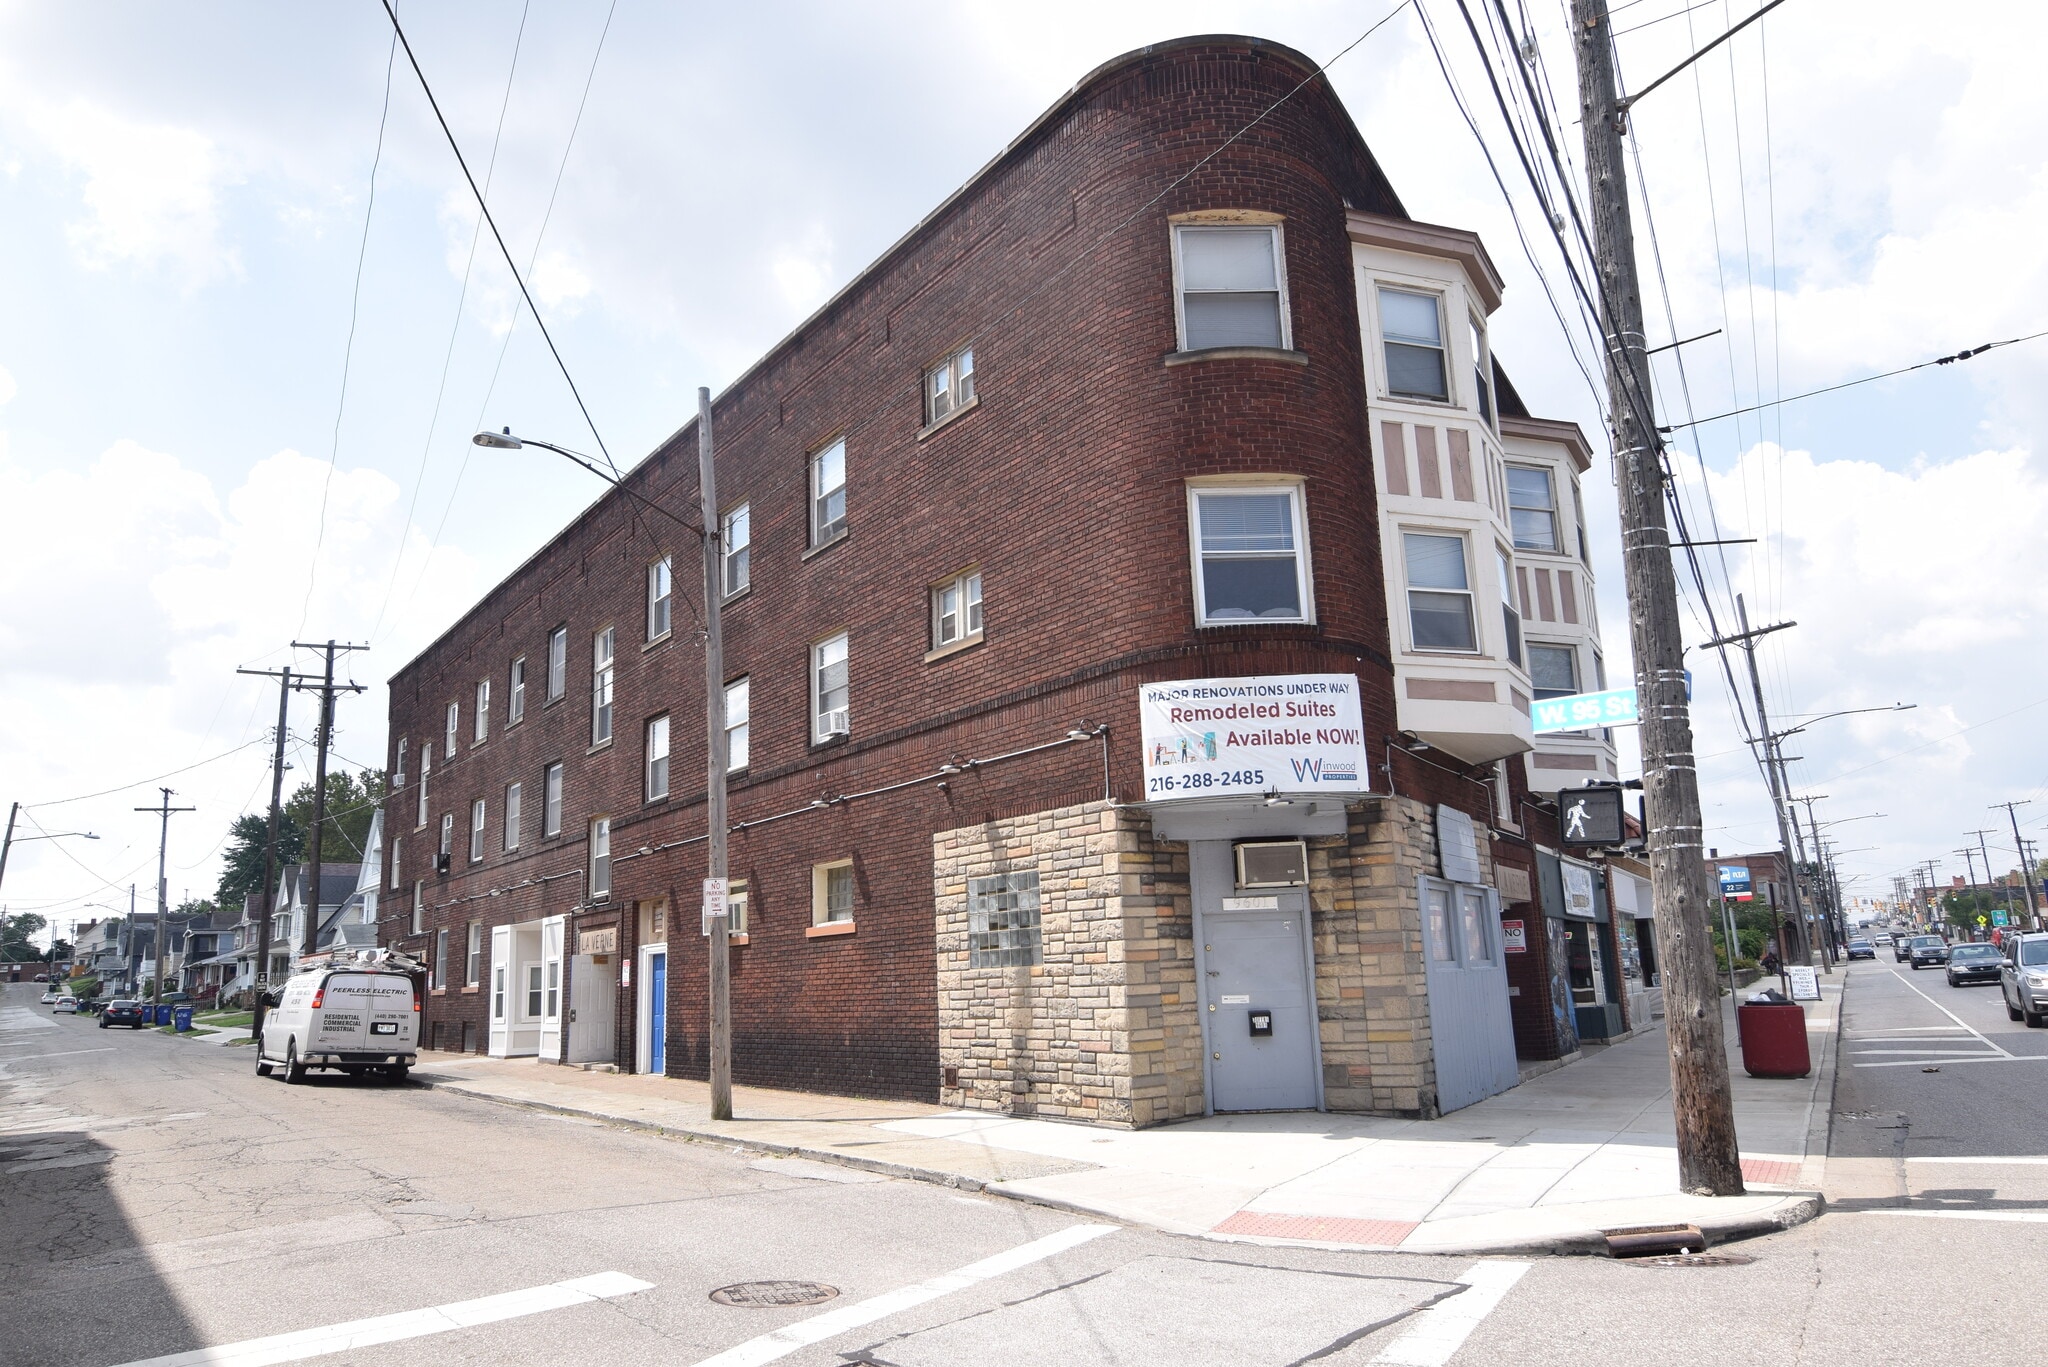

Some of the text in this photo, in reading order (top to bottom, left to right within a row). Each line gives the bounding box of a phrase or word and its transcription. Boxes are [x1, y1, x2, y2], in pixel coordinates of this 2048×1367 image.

[1148, 683, 1350, 703] MAJOR RENOVATIONS UNDER WAY
[1170, 701, 1336, 723] Remodeled Suites
[1539, 696, 1633, 725] W. 95 St
[1226, 728, 1360, 747] Available NOW!
[1150, 770, 1264, 792] 216-288-2485
[581, 932, 614, 951] LA VERNE
[1504, 928, 1522, 937] NO
